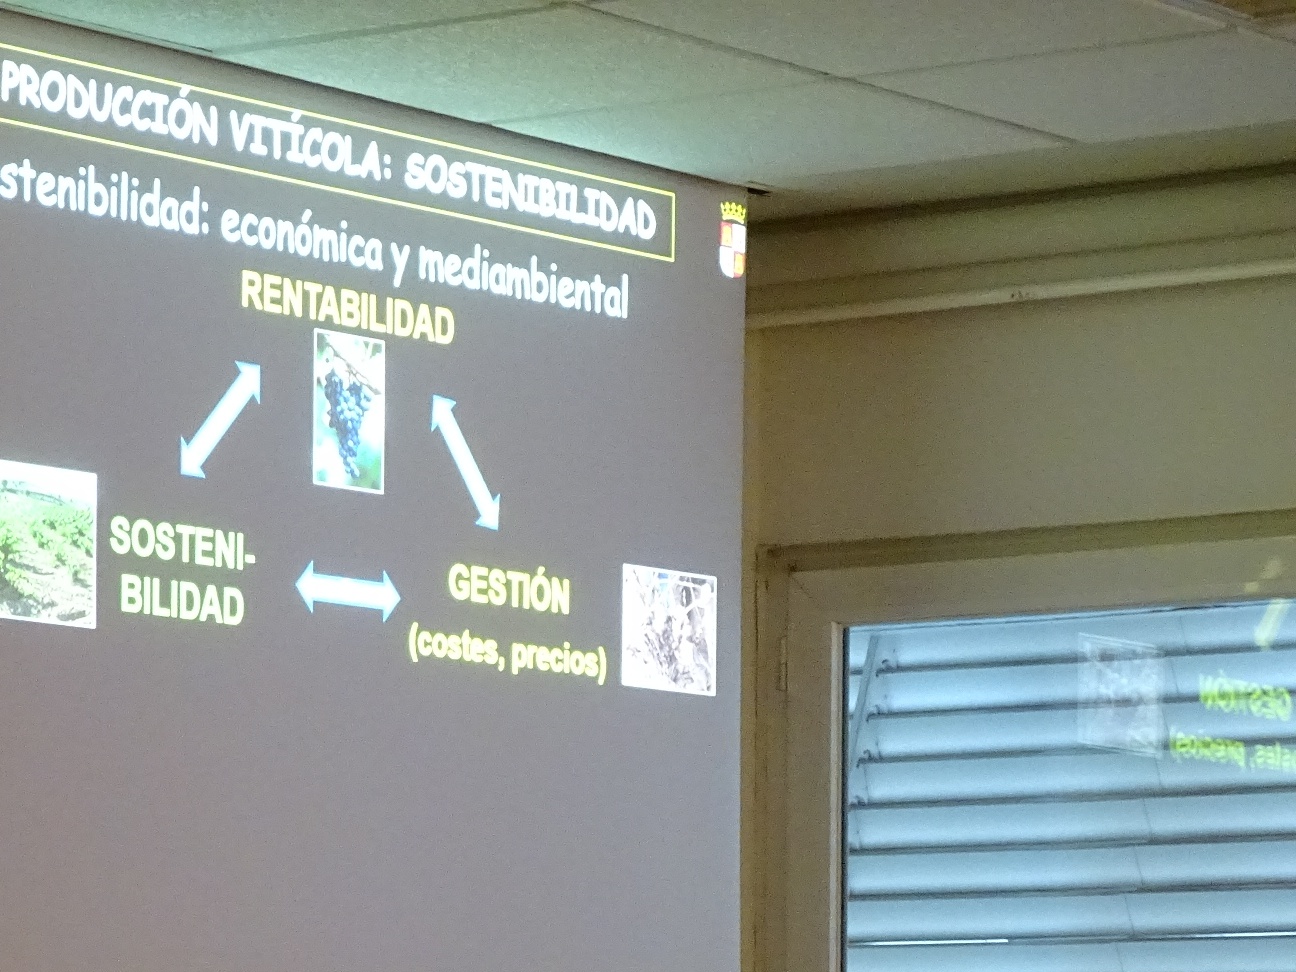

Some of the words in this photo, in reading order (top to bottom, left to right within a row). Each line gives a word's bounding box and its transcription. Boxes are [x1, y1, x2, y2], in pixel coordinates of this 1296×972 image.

[1, 59, 219, 146] PRODUCCIÓN
[230, 109, 392, 181] VITÍCOLA:
[404, 152, 657, 240] SOSTENIBILIDAD
[220, 208, 384, 271] económica
[390, 241, 410, 288] y
[418, 244, 630, 319] mediambiental
[241, 269, 455, 345] RENTABILIDAD
[109, 515, 256, 571] SOSTENI-
[121, 573, 245, 625] BILIDAD
[448, 563, 570, 615] GESTIÓN
[408, 621, 505, 672] (costes,
[511, 642, 607, 686] precios)
